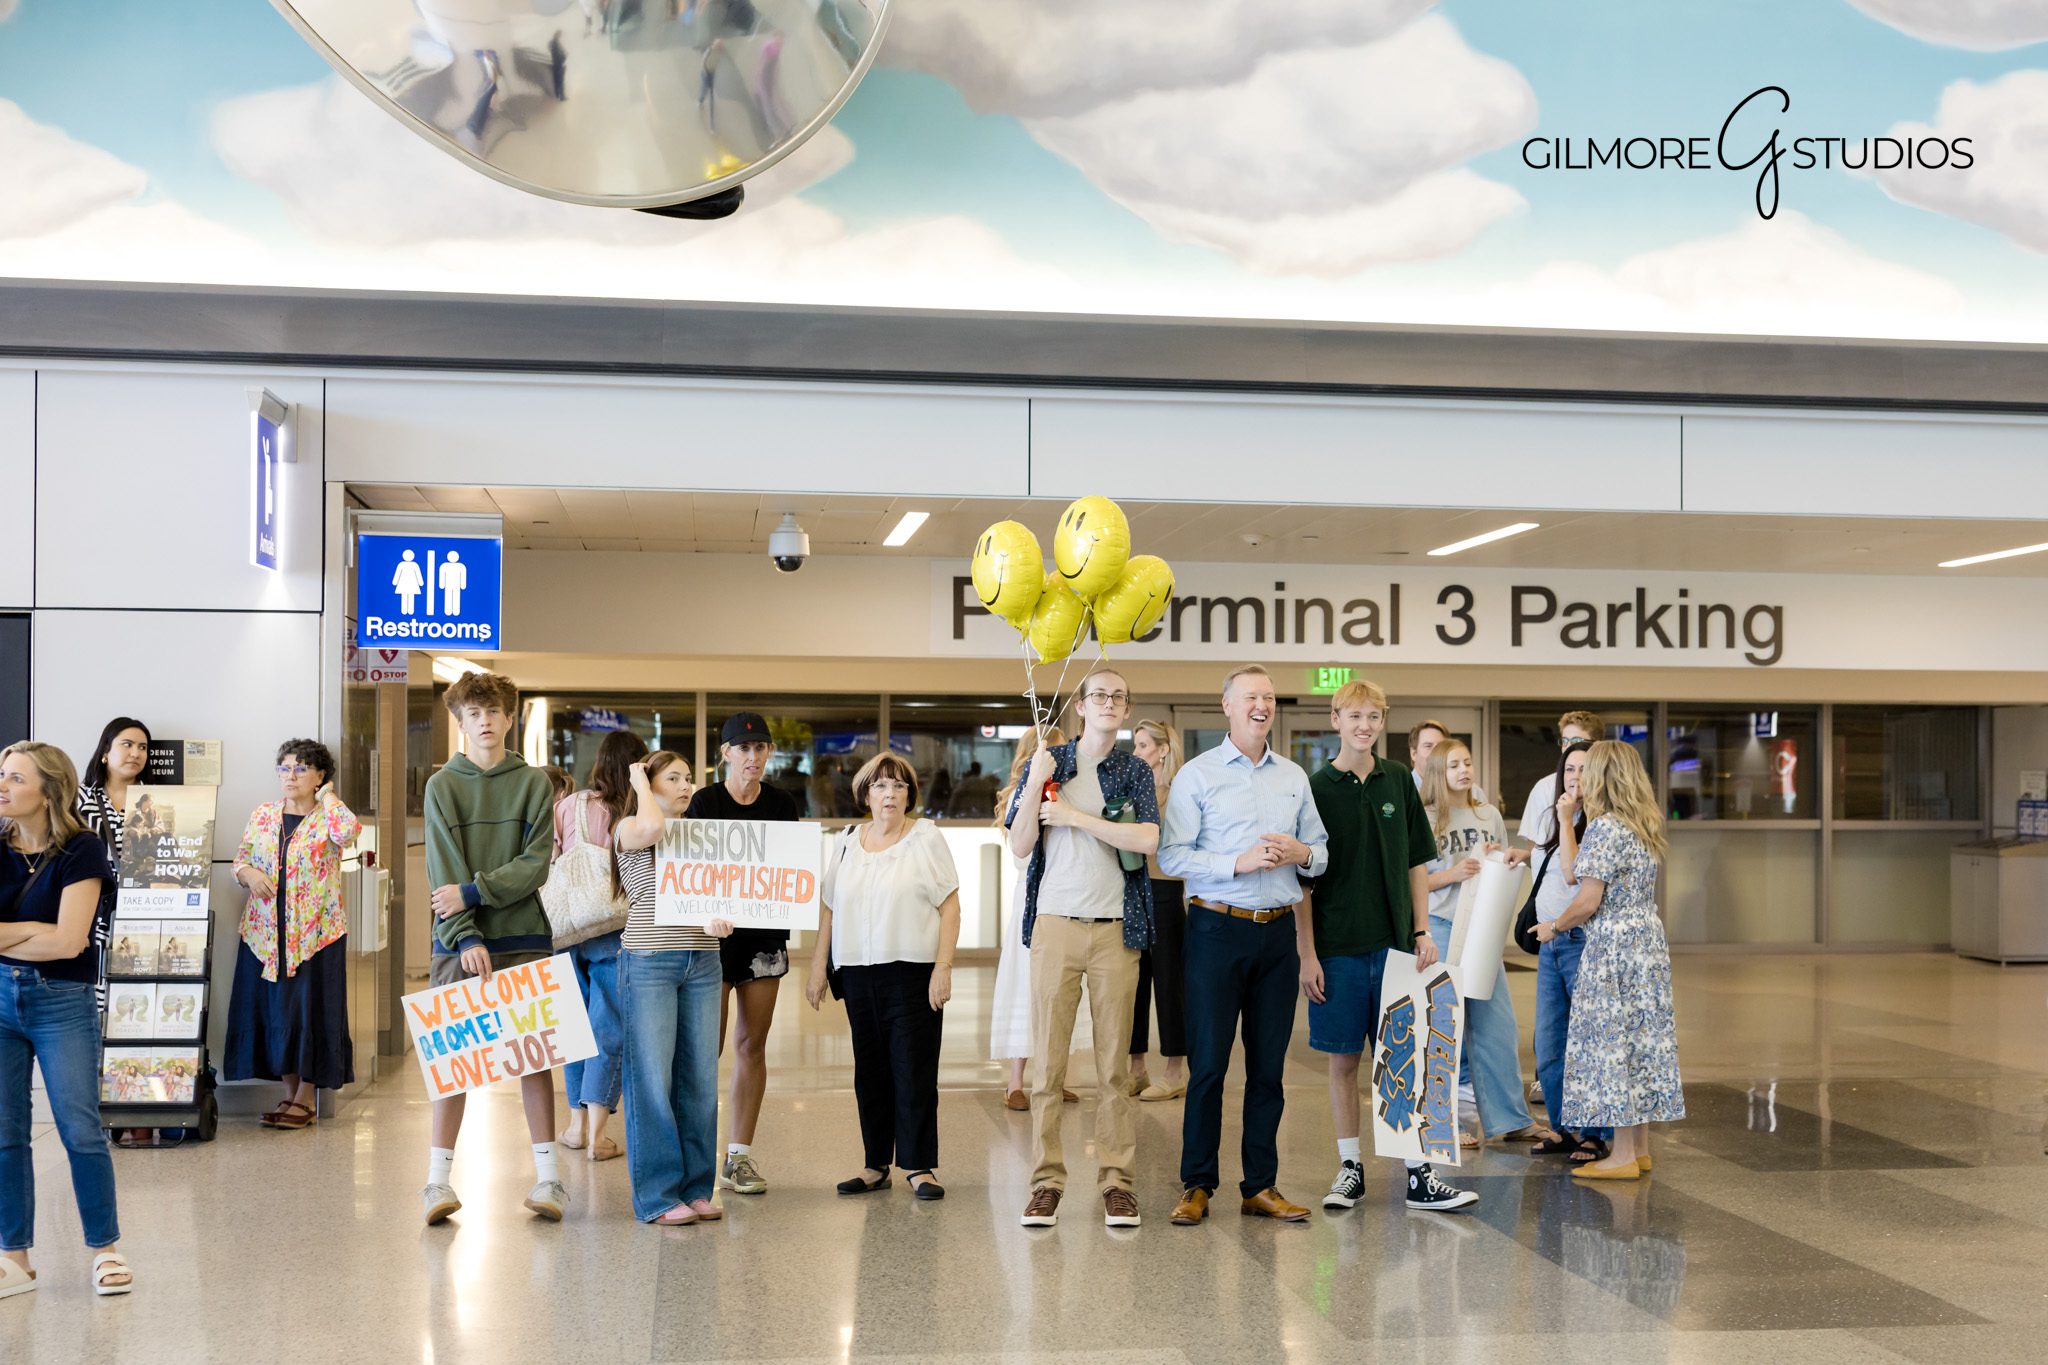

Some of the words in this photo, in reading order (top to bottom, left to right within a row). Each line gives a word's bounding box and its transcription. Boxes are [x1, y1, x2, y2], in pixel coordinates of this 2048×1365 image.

[366, 616, 492, 639] Restrooms
[1435, 584, 1476, 646] 3
[1511, 585, 1783, 666] Parking
[1318, 667, 1351, 688] EXIT
[157, 836, 175, 846] An
[178, 836, 203, 846] End
[157, 848, 171, 857] to
[173, 848, 199, 857] War
[657, 821, 767, 862] MISSION
[154, 864, 202, 876] HOW?
[659, 861, 815, 904] ACCOMPLISHED
[122, 896, 142, 905] TAKE
[145, 896, 150, 905] A
[153, 896, 174, 905] COPY
[674, 899, 738, 915] WELCOME
[743, 902, 790, 920] HOME!!!
[409, 959, 560, 1029] WELCOME
[418, 1010, 503, 1061] HOME!
[508, 997, 560, 1034] WE
[430, 1046, 502, 1095] LOVE
[502, 1028, 566, 1077] JOE
[1416, 970, 1459, 1163] WELCOME
